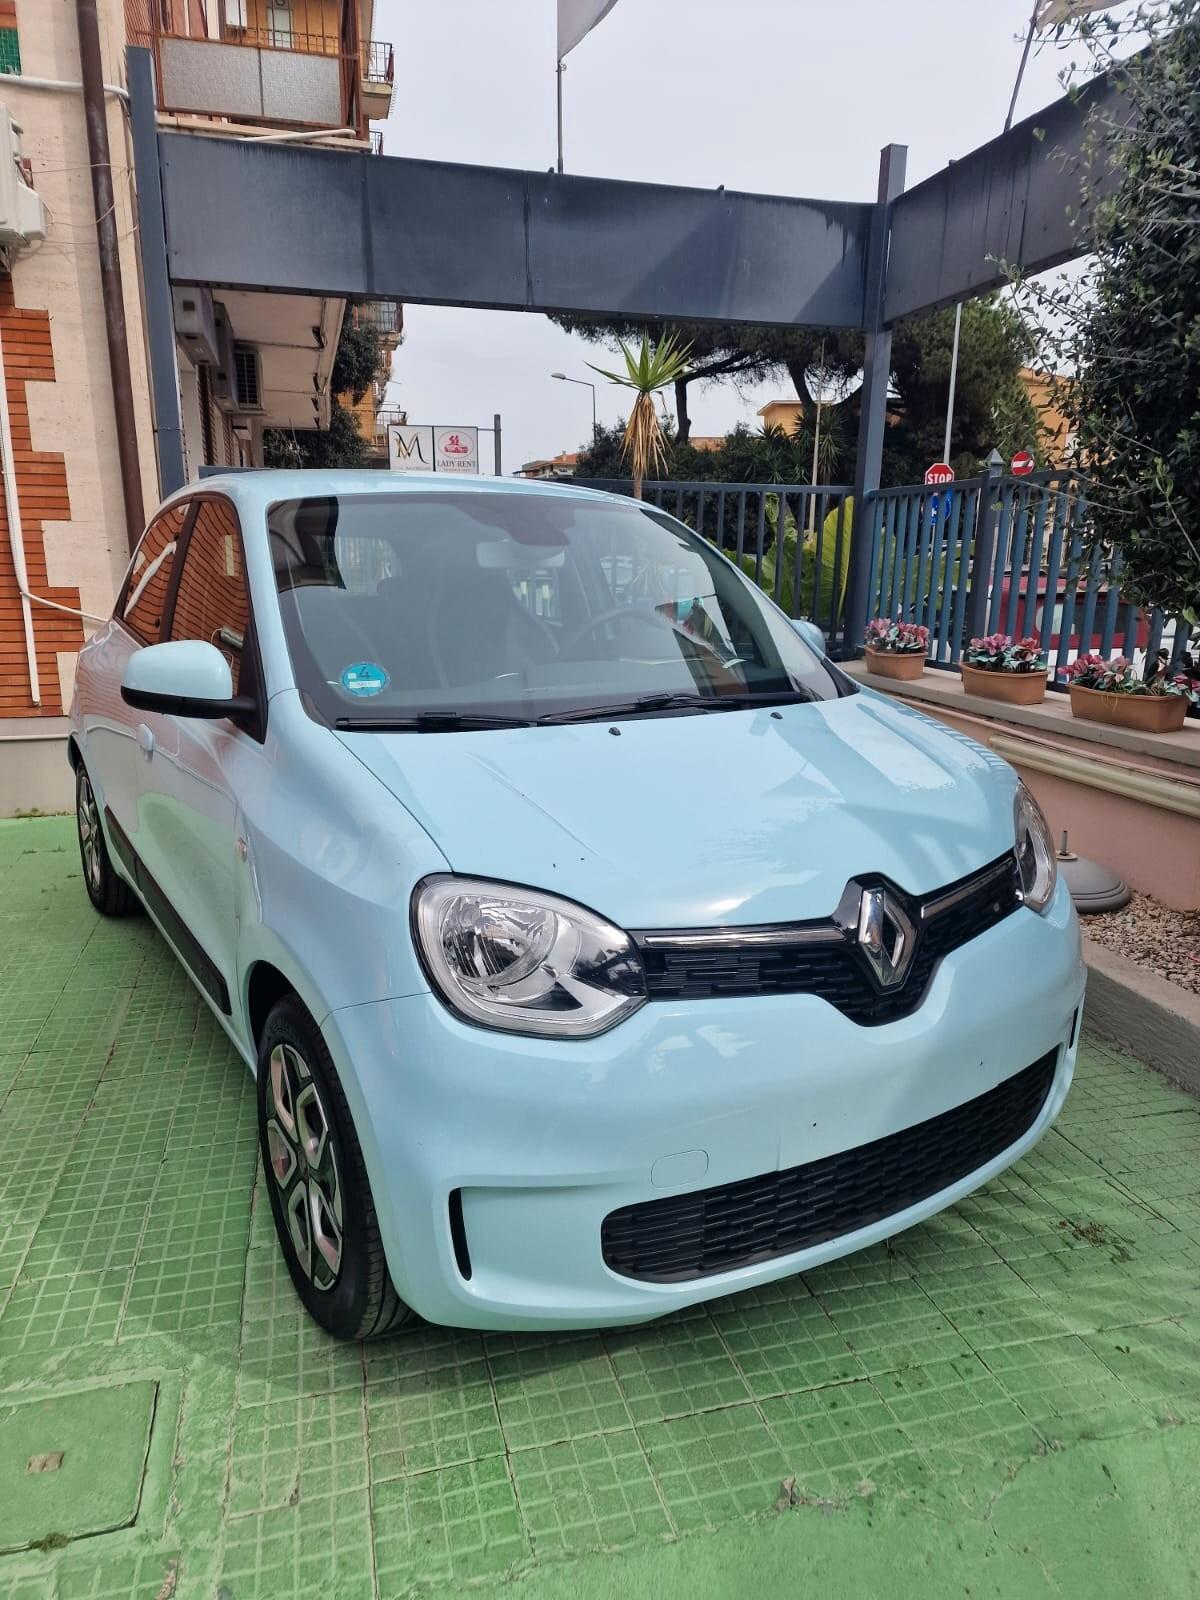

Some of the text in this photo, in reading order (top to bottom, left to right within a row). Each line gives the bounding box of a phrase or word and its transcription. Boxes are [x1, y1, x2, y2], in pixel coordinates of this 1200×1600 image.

[437, 460, 477, 468] LADY RENT
[927, 473, 952, 485] STOP
[359, 666, 370, 679] 4
